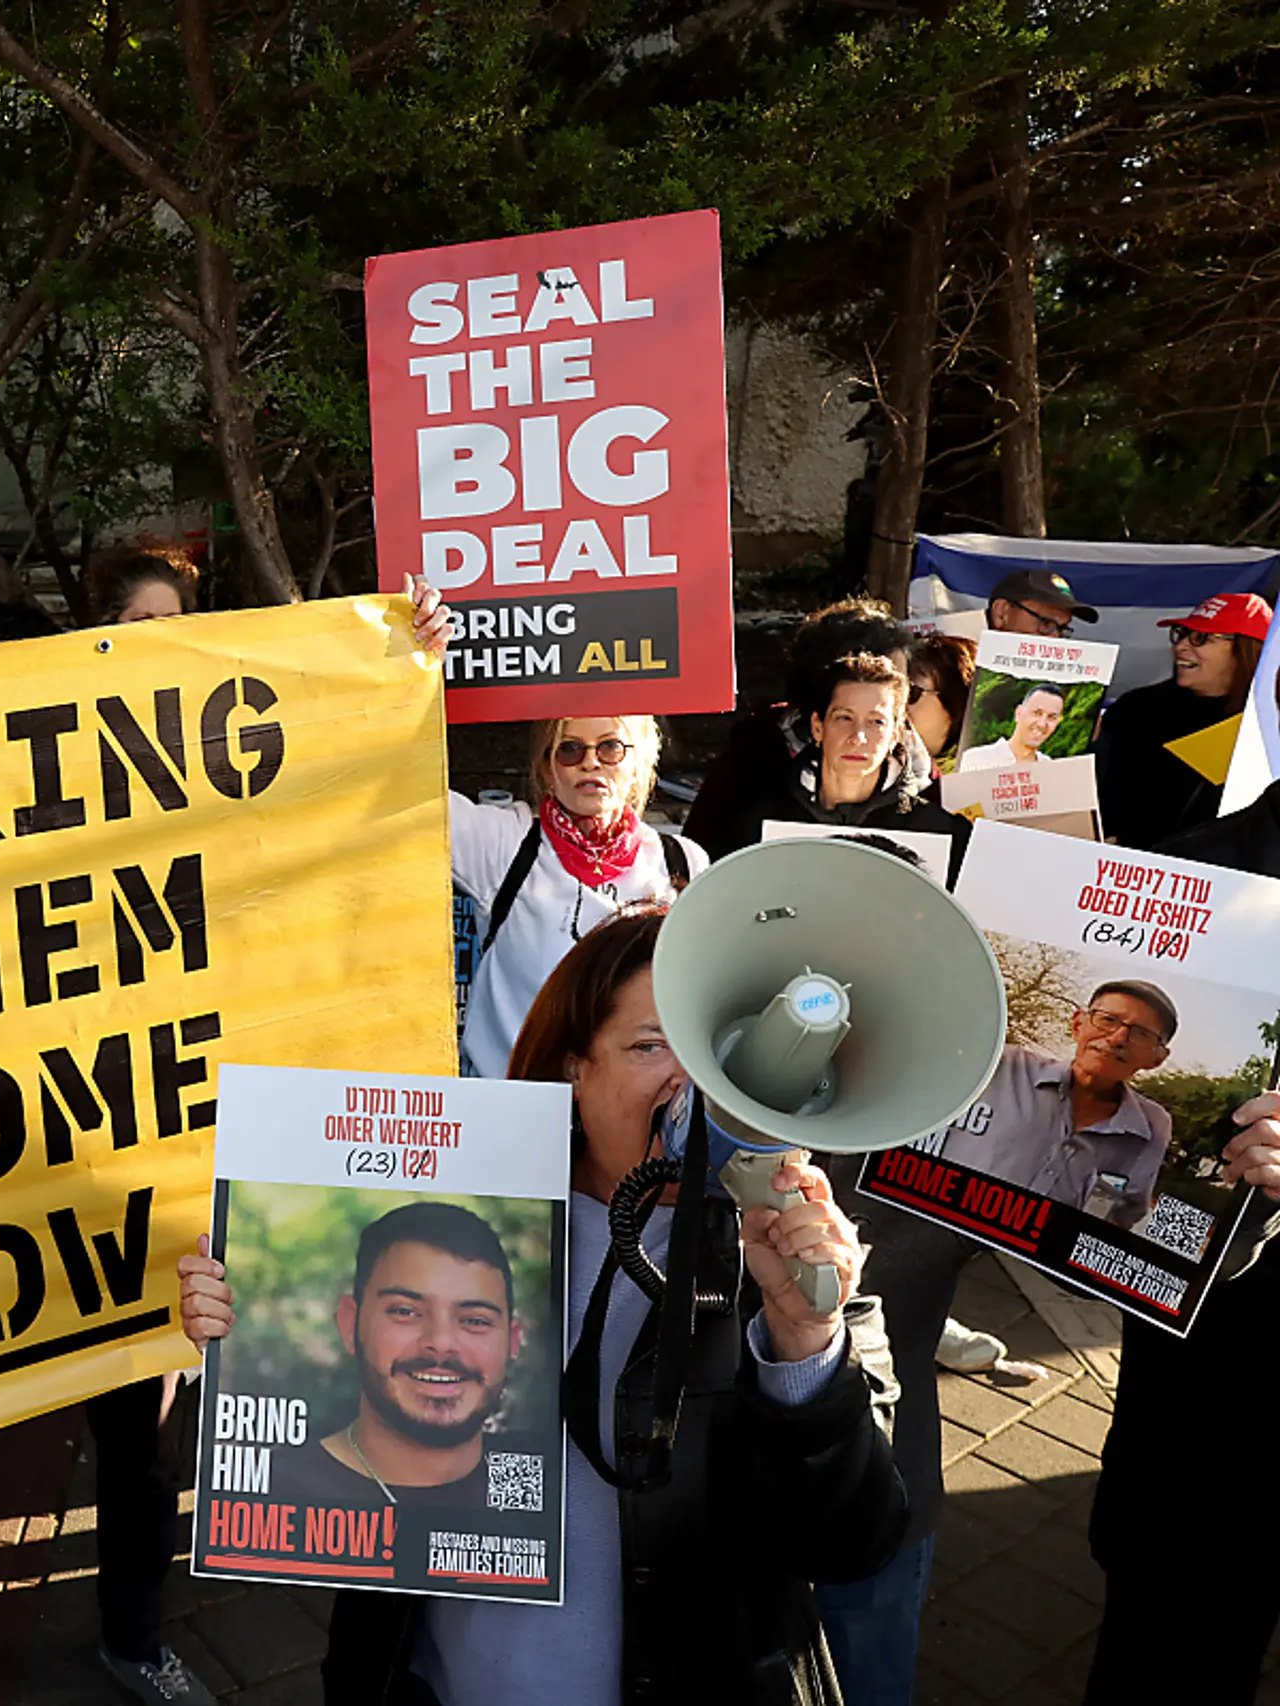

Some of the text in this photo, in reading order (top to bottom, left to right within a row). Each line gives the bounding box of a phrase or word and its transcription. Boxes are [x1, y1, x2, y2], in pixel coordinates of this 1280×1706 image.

[407, 259, 654, 345] SEAL
[408, 337, 596, 415] THE
[416, 404, 670, 520] BIG
[422, 514, 678, 590] DEAL
[445, 638, 668, 680] THEM ALL
[1096, 858, 1212, 904] עודד ליפשיץ
[1078, 885, 1213, 934] ODED LIFSHITZ
[1082, 919, 1146, 953] (84)
[345, 1086, 444, 1118] עומר ונקרט
[324, 1115, 463, 1149] OMER WENKERT
[345, 1148, 398, 1180] (23)
[877, 1149, 1053, 1239] HOME NOW!
[1068, 1243, 1183, 1311] FAMILIES FORUM
[215, 1393, 308, 1446] BRING
[212, 1444, 271, 1494] HIM
[209, 1500, 398, 1561] HOME NOW!
[428, 1531, 480, 1551] HOSTAGES
[481, 1535, 501, 1553] AND
[428, 1548, 547, 1579] FAMILIES FORUM
